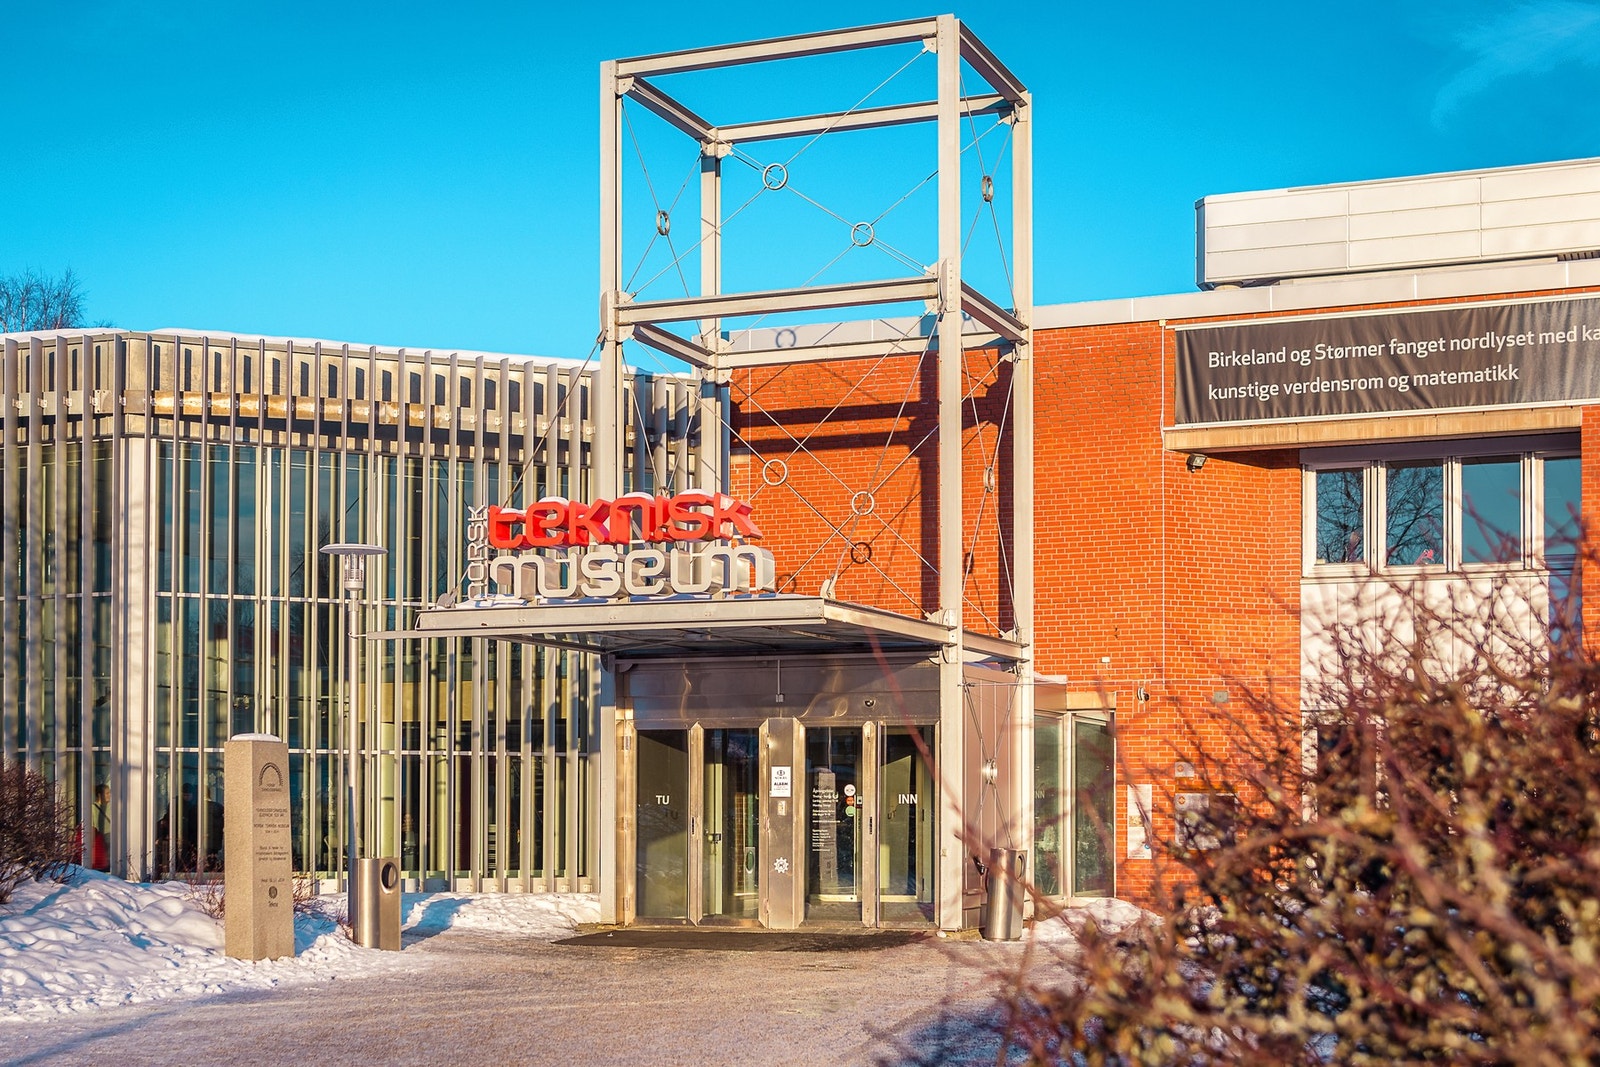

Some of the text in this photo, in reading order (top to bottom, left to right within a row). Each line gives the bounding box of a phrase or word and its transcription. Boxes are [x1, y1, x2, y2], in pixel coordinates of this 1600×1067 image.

[1208, 346, 1286, 368] Birkeland
[1290, 349, 1311, 366] og
[1315, 342, 1386, 361] Størmer
[1389, 338, 1446, 358] fanget
[1450, 331, 1534, 352] nordlyset
[1538, 325, 1578, 345] med
[1208, 363, 1519, 402] kunstige verdensrom og matematikk
[489, 545, 775, 600] museum
[655, 795, 670, 805] TU
[898, 793, 918, 805] INN
